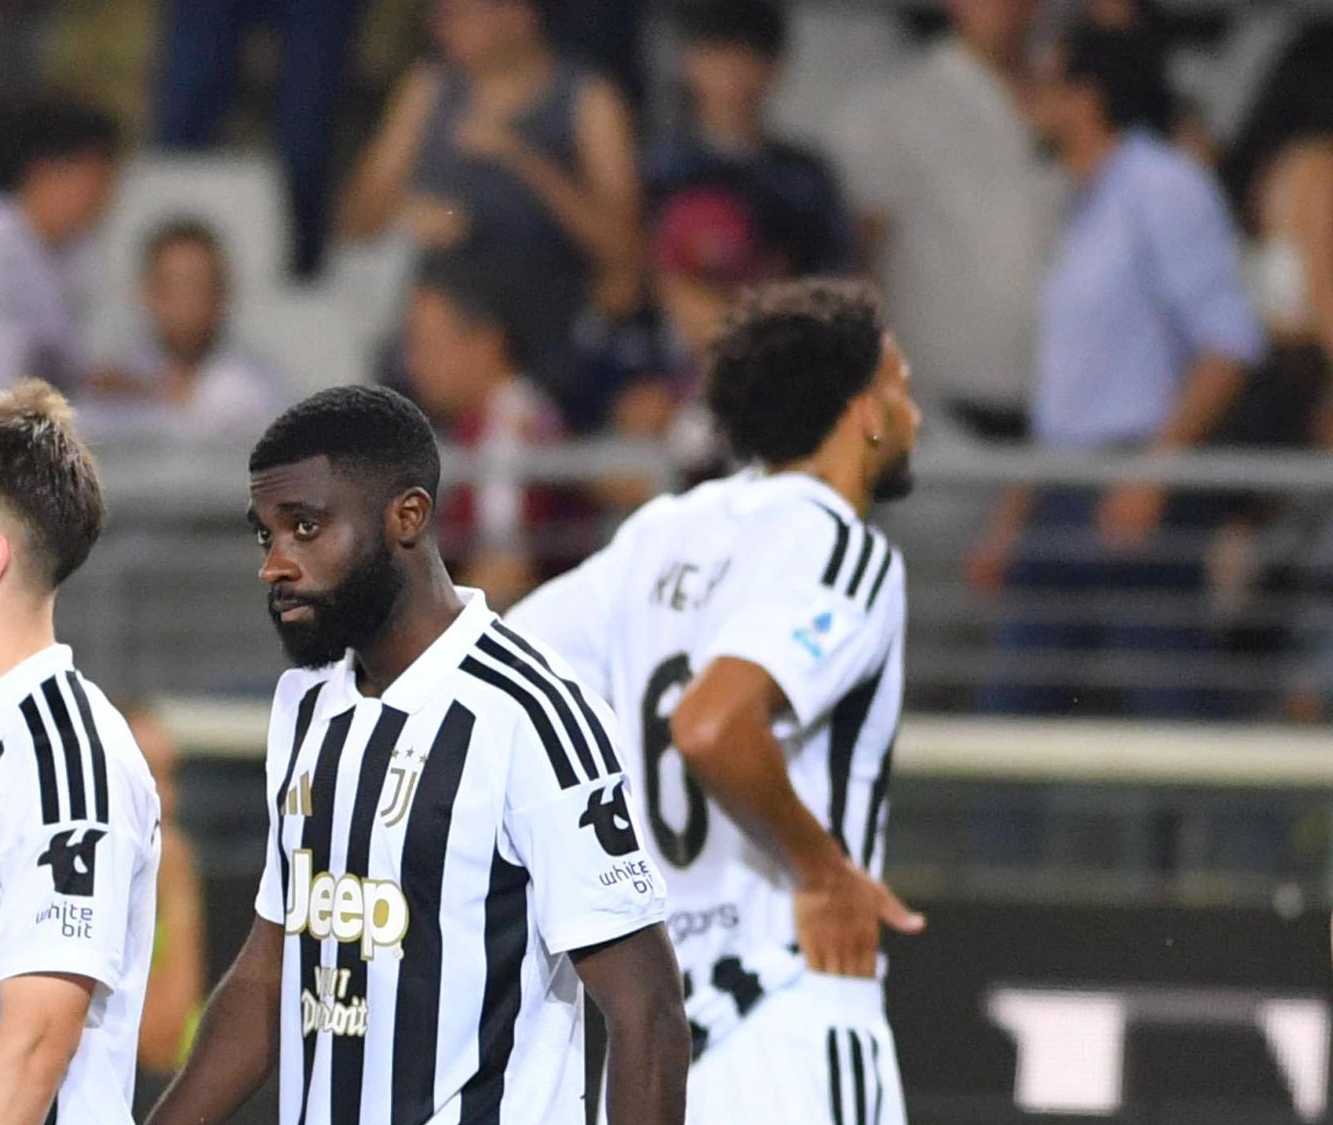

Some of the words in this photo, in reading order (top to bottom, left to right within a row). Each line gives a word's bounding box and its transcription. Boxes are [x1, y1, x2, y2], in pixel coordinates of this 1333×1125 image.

[598, 860, 649, 886] white
[36, 901, 93, 924] white
[284, 848, 410, 962] Jeep
[62, 920, 93, 939] bit
